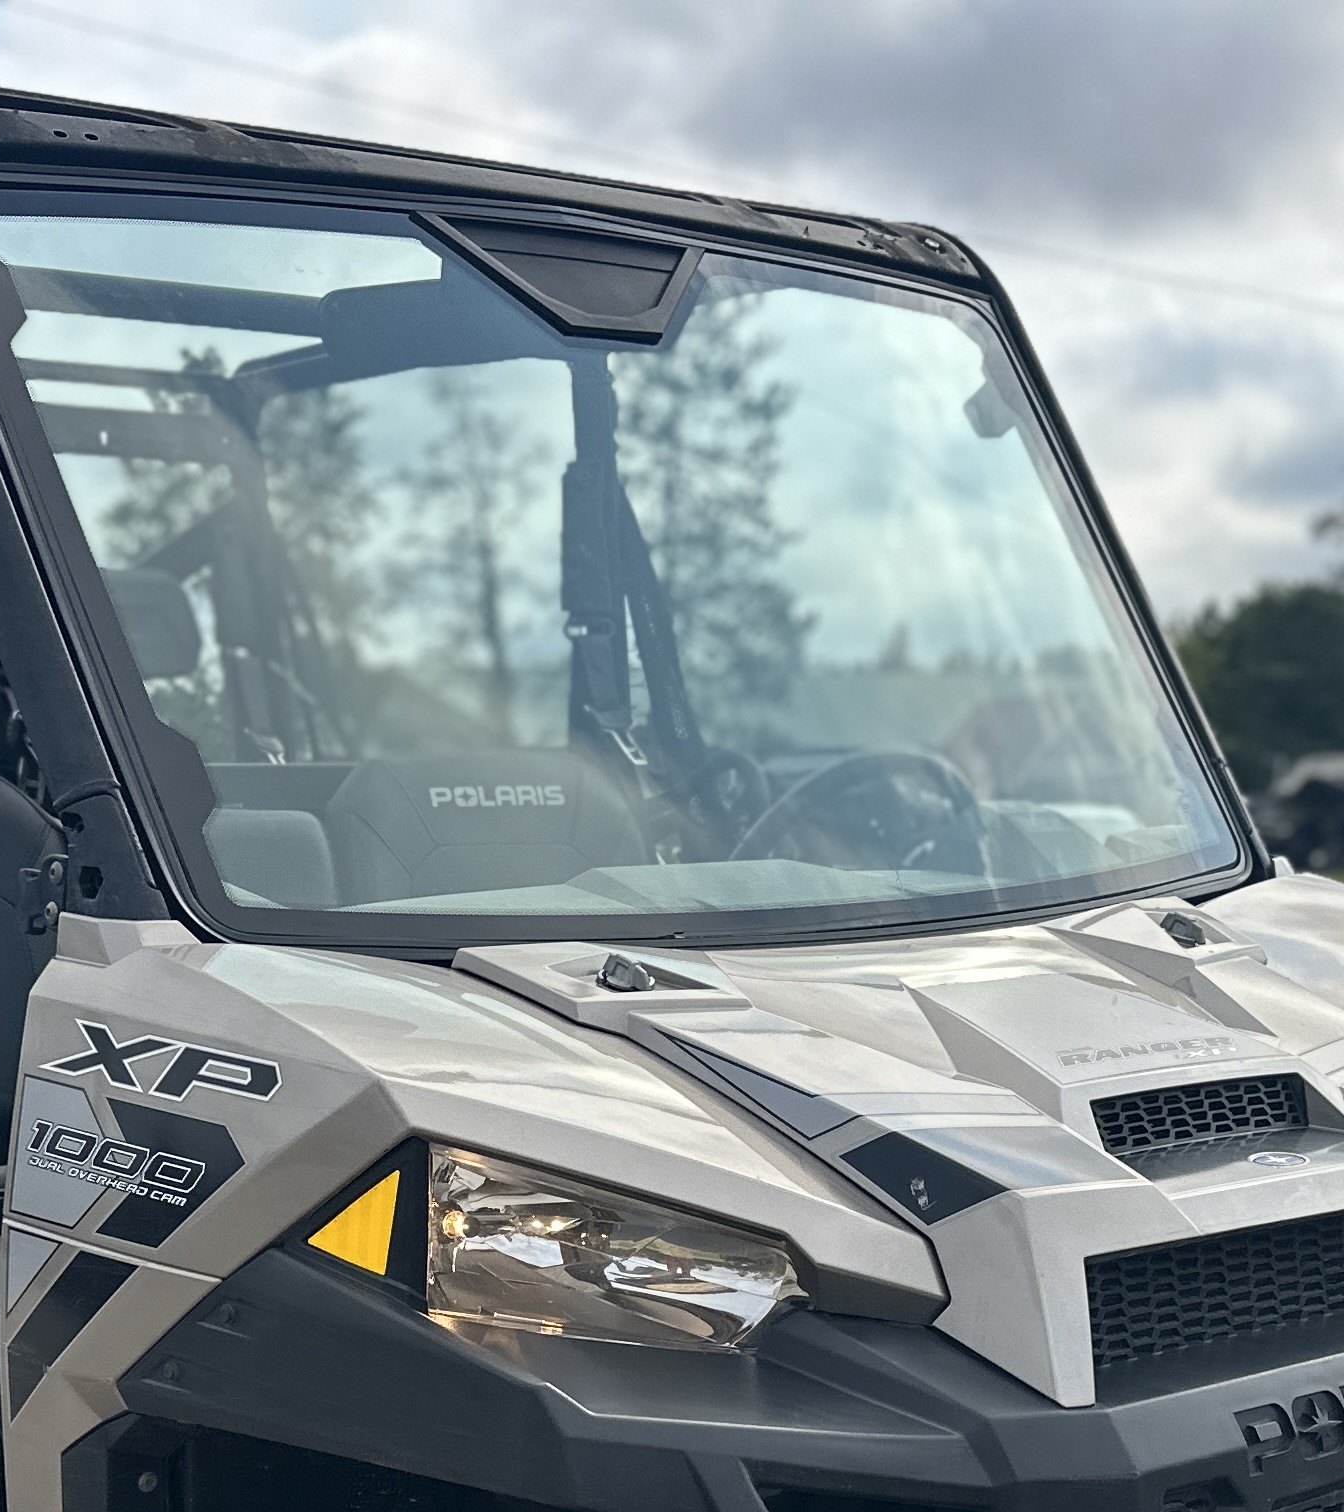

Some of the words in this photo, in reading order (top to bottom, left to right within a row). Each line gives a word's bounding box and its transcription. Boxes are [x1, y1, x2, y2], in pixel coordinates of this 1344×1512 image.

[430, 785, 565, 808] POLARIS
[38, 1017, 284, 1102] XP
[1057, 1036, 1233, 1068] RANGER
[26, 1119, 206, 1193] 1000
[28, 1156, 65, 1174] DUAL
[68, 1166, 148, 1196] OVERHEAD
[150, 1190, 188, 1207] CAM
